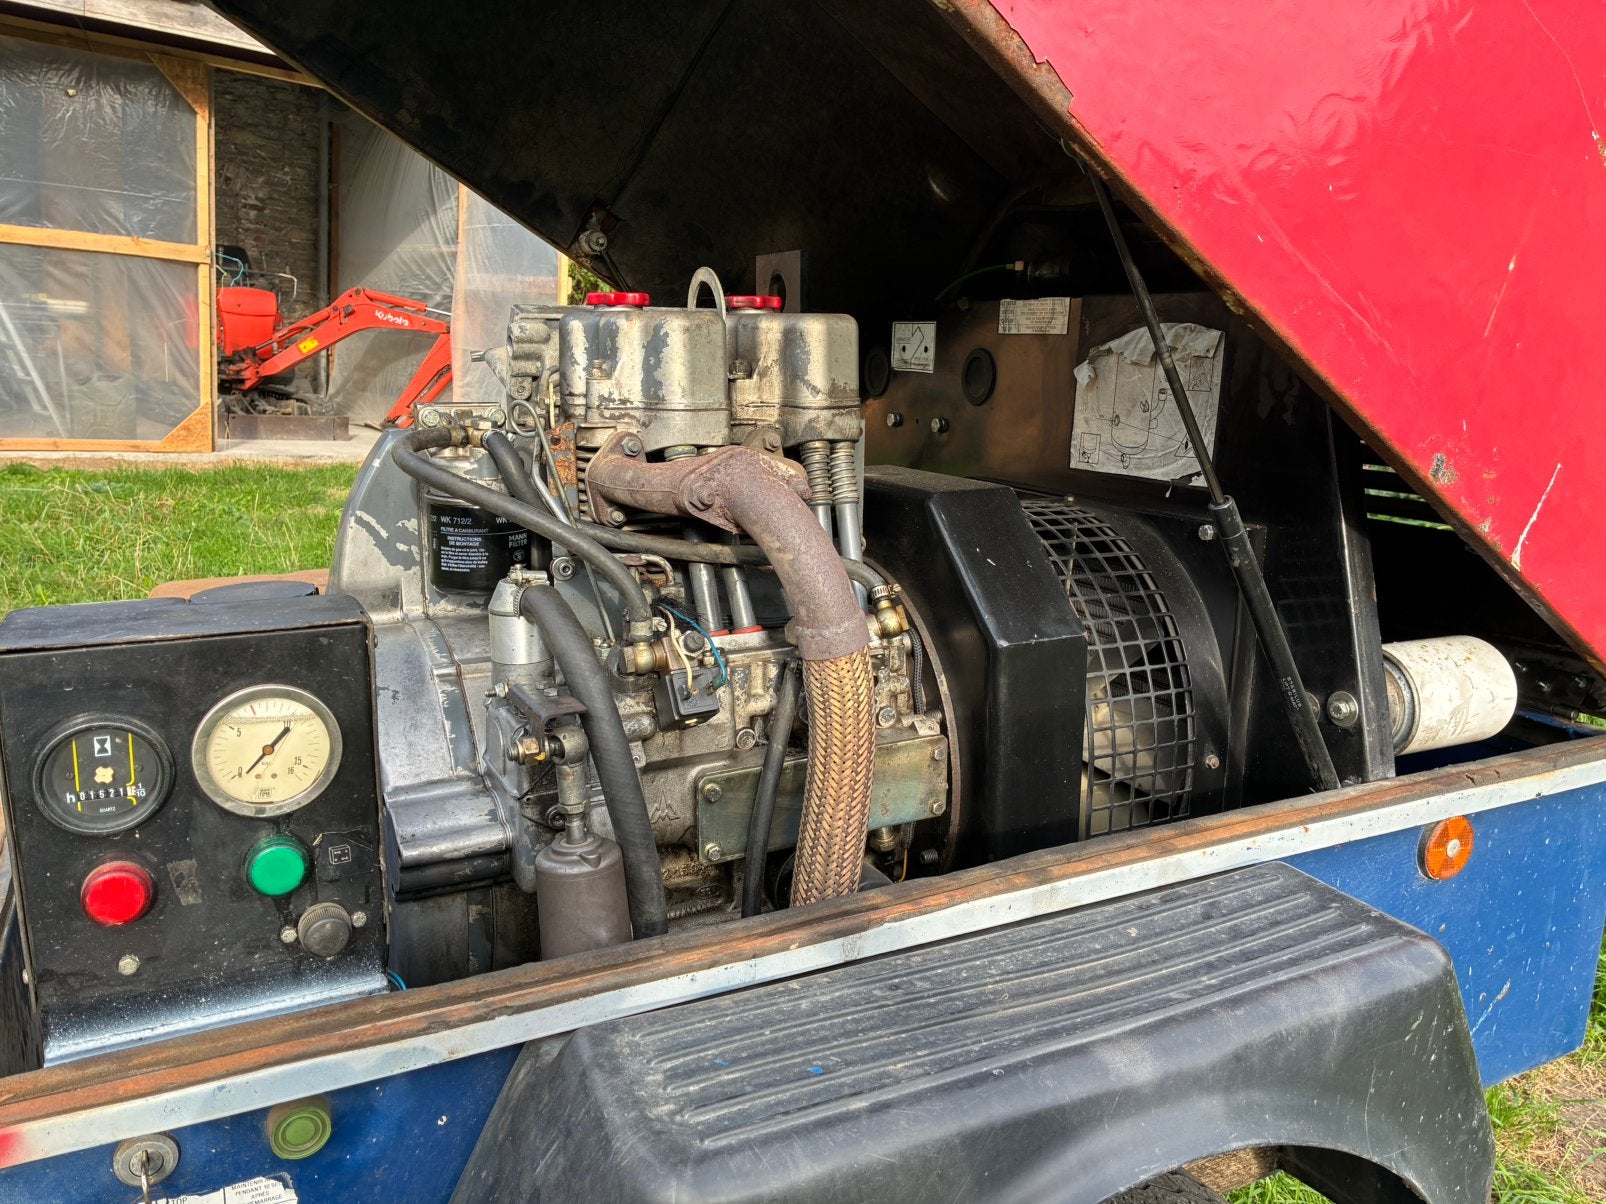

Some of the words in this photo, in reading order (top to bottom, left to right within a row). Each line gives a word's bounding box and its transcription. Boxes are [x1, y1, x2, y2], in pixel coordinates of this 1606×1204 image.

[375, 309, 409, 327] Kubota
[440, 516, 451, 524] WK
[236, 727, 242, 738] 5
[294, 756, 302, 766] 15
[66, 792, 76, 803] h
[235, 1185, 262, 1196] PENDANT
